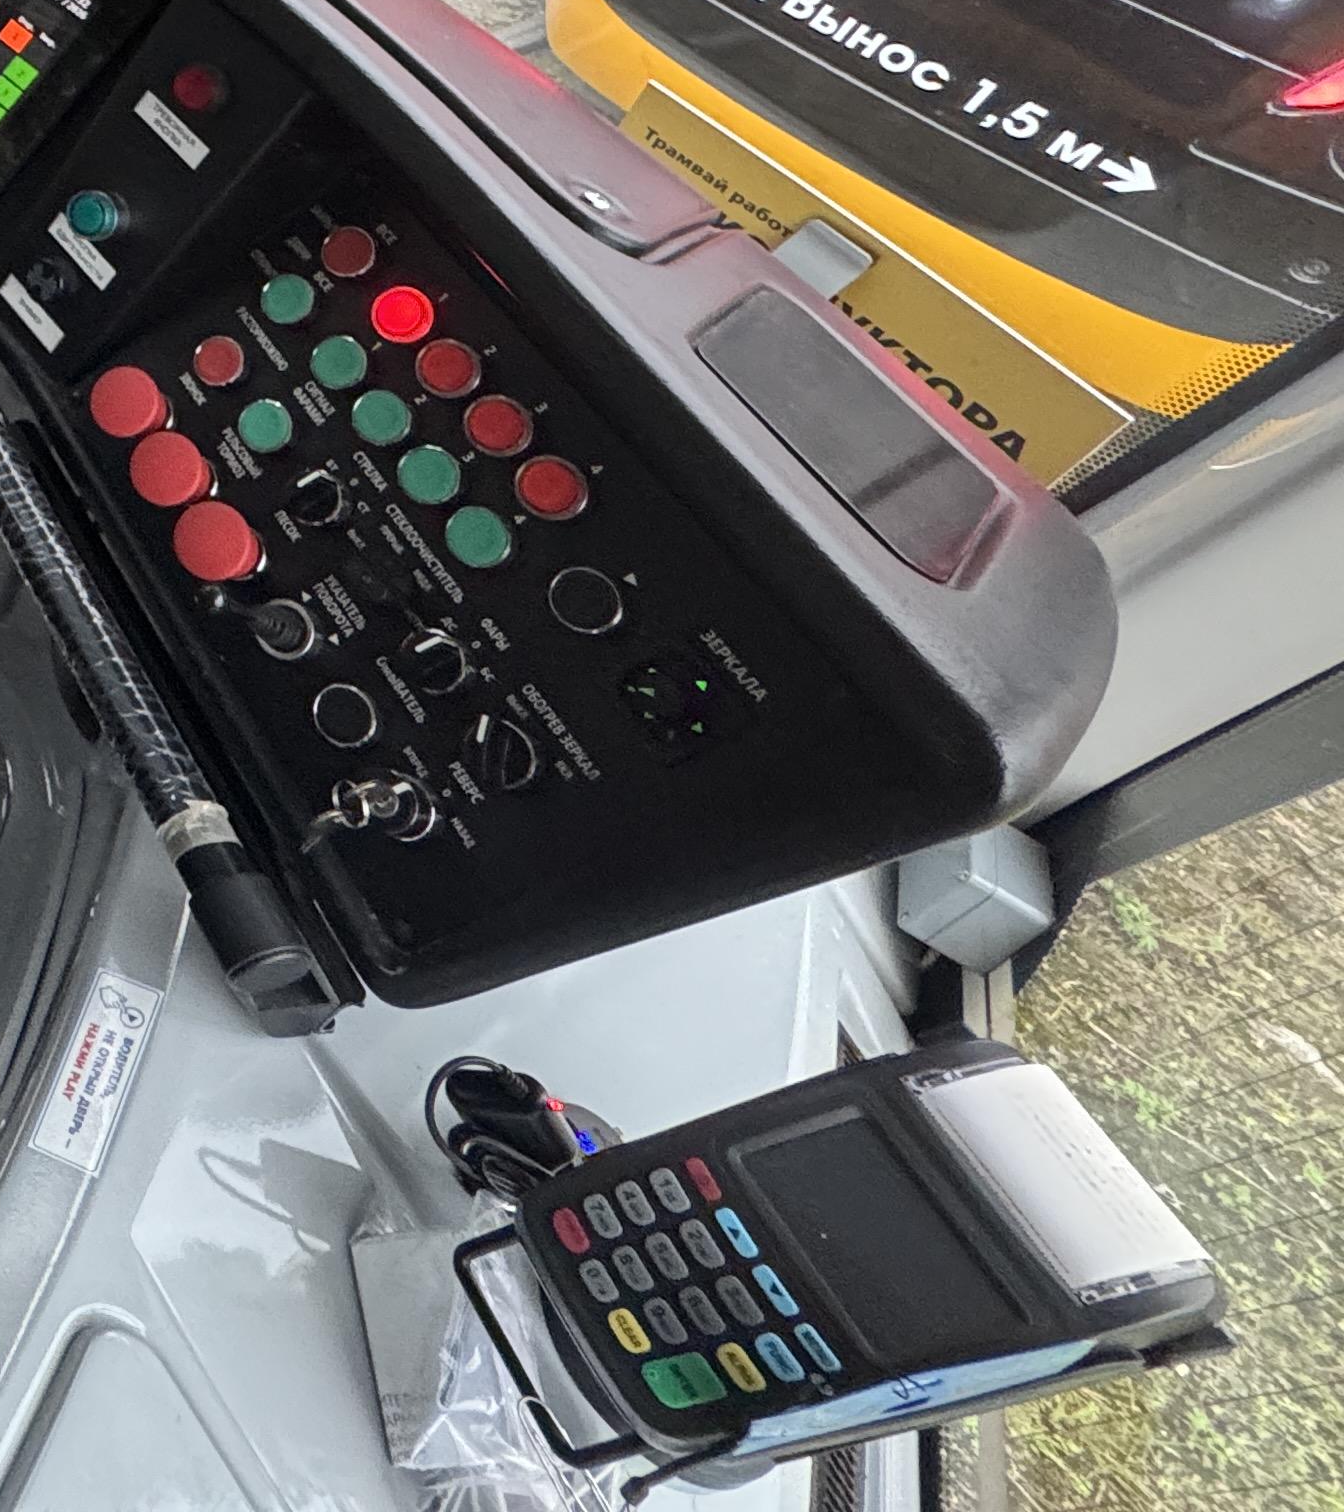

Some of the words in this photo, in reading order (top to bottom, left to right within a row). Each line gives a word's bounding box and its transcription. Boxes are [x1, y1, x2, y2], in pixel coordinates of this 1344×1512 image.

[963, 78, 1050, 139] 1,5
[643, 126, 729, 195] Трамвай
[377, 223, 396, 245] ВСЕ
[237, 305, 287, 371] РАСТОРМОЖЕНО
[292, 386, 323, 425] ФАРАМИ
[304, 380, 333, 416] СИГНАЛ
[216, 442, 245, 478] ТОРМОЗ
[220, 427, 261, 478] РЕЛЬСОВЫЙ
[354, 451, 385, 491] СТРЕЛКА
[274, 509, 300, 541] ПЕСОК
[384, 501, 464, 606] СТЕКЛООЧИСТИТЕЛЬ
[312, 583, 354, 637] ПОВОРОТА
[323, 574, 366, 630] УКАЗАТЕЛЬ
[480, 616, 509, 651] ФАРЫ
[700, 629, 768, 702] ЗЕРКАЛА
[521, 681, 565, 736] ОБОГРЕВ
[560, 732, 599, 781] ЗЕРКАЛ
[448, 761, 482, 803] РЕВЕРС
[72, 1022, 101, 1070] НАЖМИ
[102, 1029, 117, 1046] НЕ
[60, 1070, 82, 1101] PLAY
[81, 1046, 111, 1096] ОТКРЫЛ
[99, 1036, 136, 1101] ВОДИТЕЛЬ,
[64, 1095, 92, 1137] ДВЕРЬ
[617, 1312, 641, 1349] CLEAR
